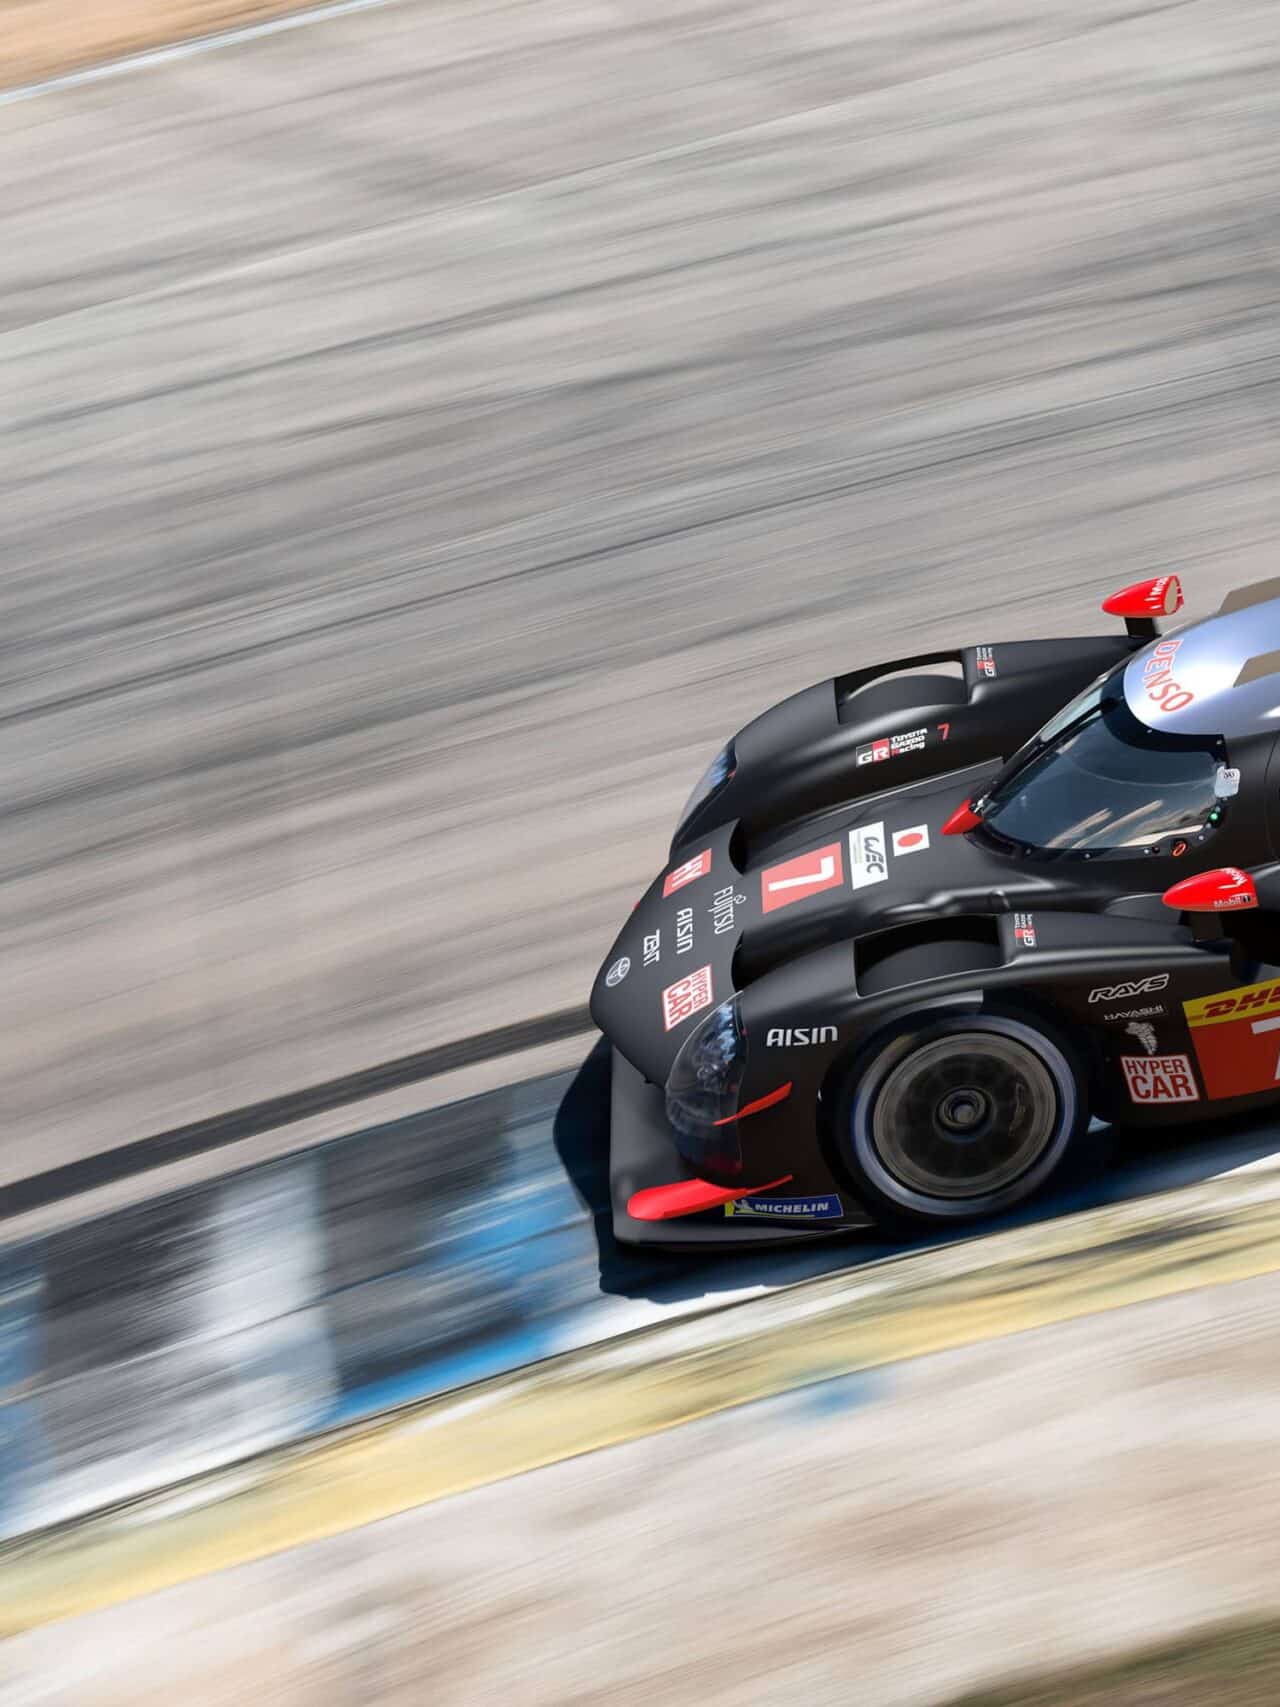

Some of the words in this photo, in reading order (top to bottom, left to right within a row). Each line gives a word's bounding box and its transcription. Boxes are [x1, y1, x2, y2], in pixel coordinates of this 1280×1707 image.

[1142, 640, 1194, 712] DENSO
[937, 722, 950, 741] 7
[857, 747, 890, 766] GR
[671, 853, 704, 888] HY
[864, 836, 884, 874] WEC
[768, 855, 836, 892] 7
[707, 885, 736, 935] FUJITSU
[643, 928, 660, 967] ZENT
[676, 907, 694, 955] AISIN
[668, 980, 692, 1025] CAR
[1088, 973, 1169, 1003] RAYS
[766, 1026, 838, 1047] AISIN
[1124, 1057, 1186, 1076] HYPER
[1131, 1072, 1194, 1100] CAR
[754, 1200, 830, 1214] MICHELIN
